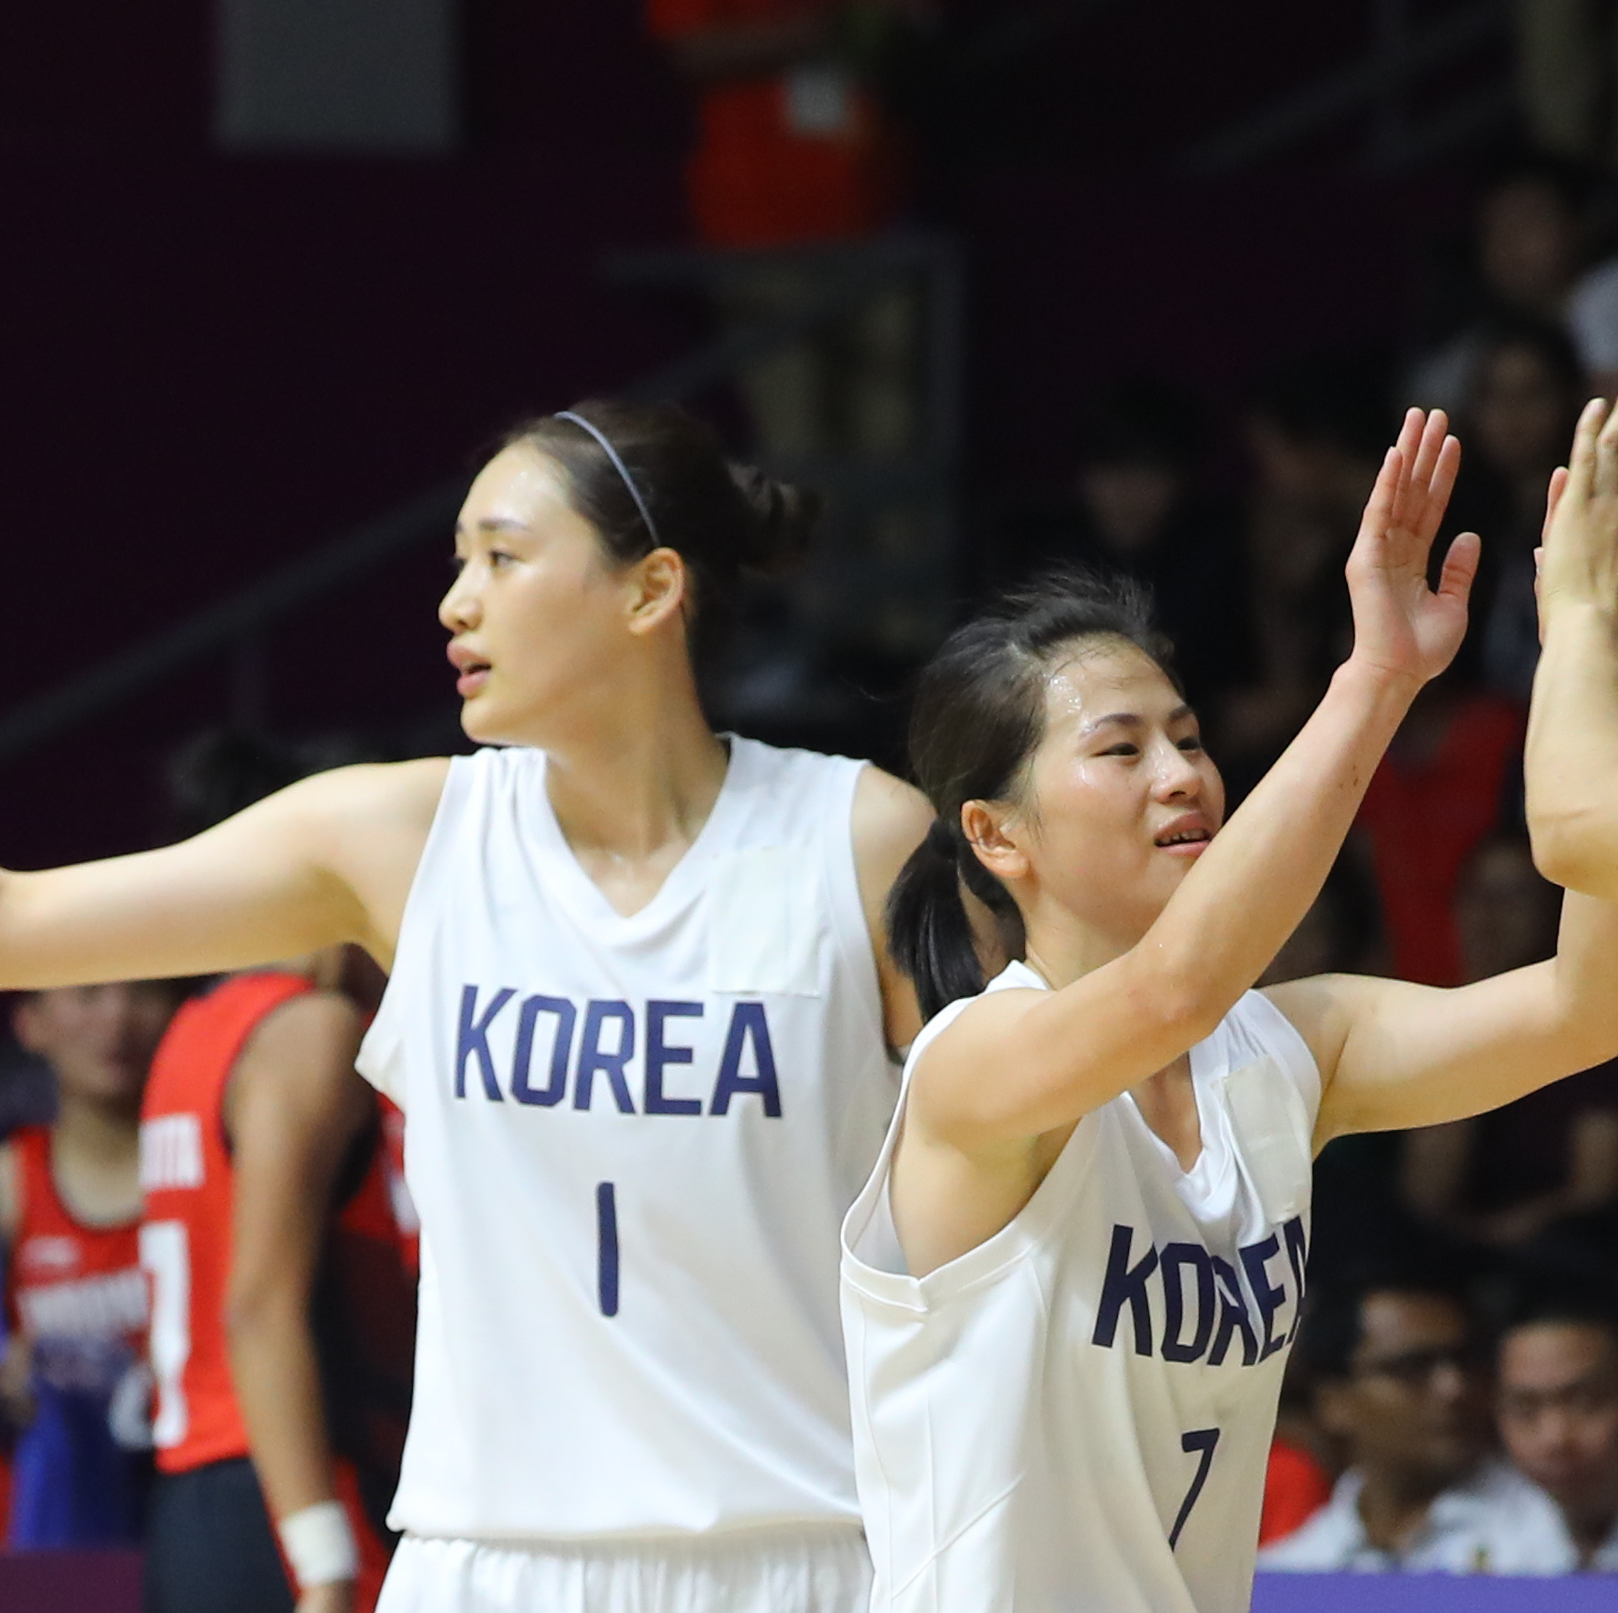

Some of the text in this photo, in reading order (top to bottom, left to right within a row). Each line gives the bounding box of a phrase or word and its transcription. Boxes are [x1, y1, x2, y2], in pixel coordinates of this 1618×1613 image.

[454, 984, 783, 1119] KOREA
[595, 1180, 621, 1318] 1
[1167, 1426, 1222, 1553] 7
